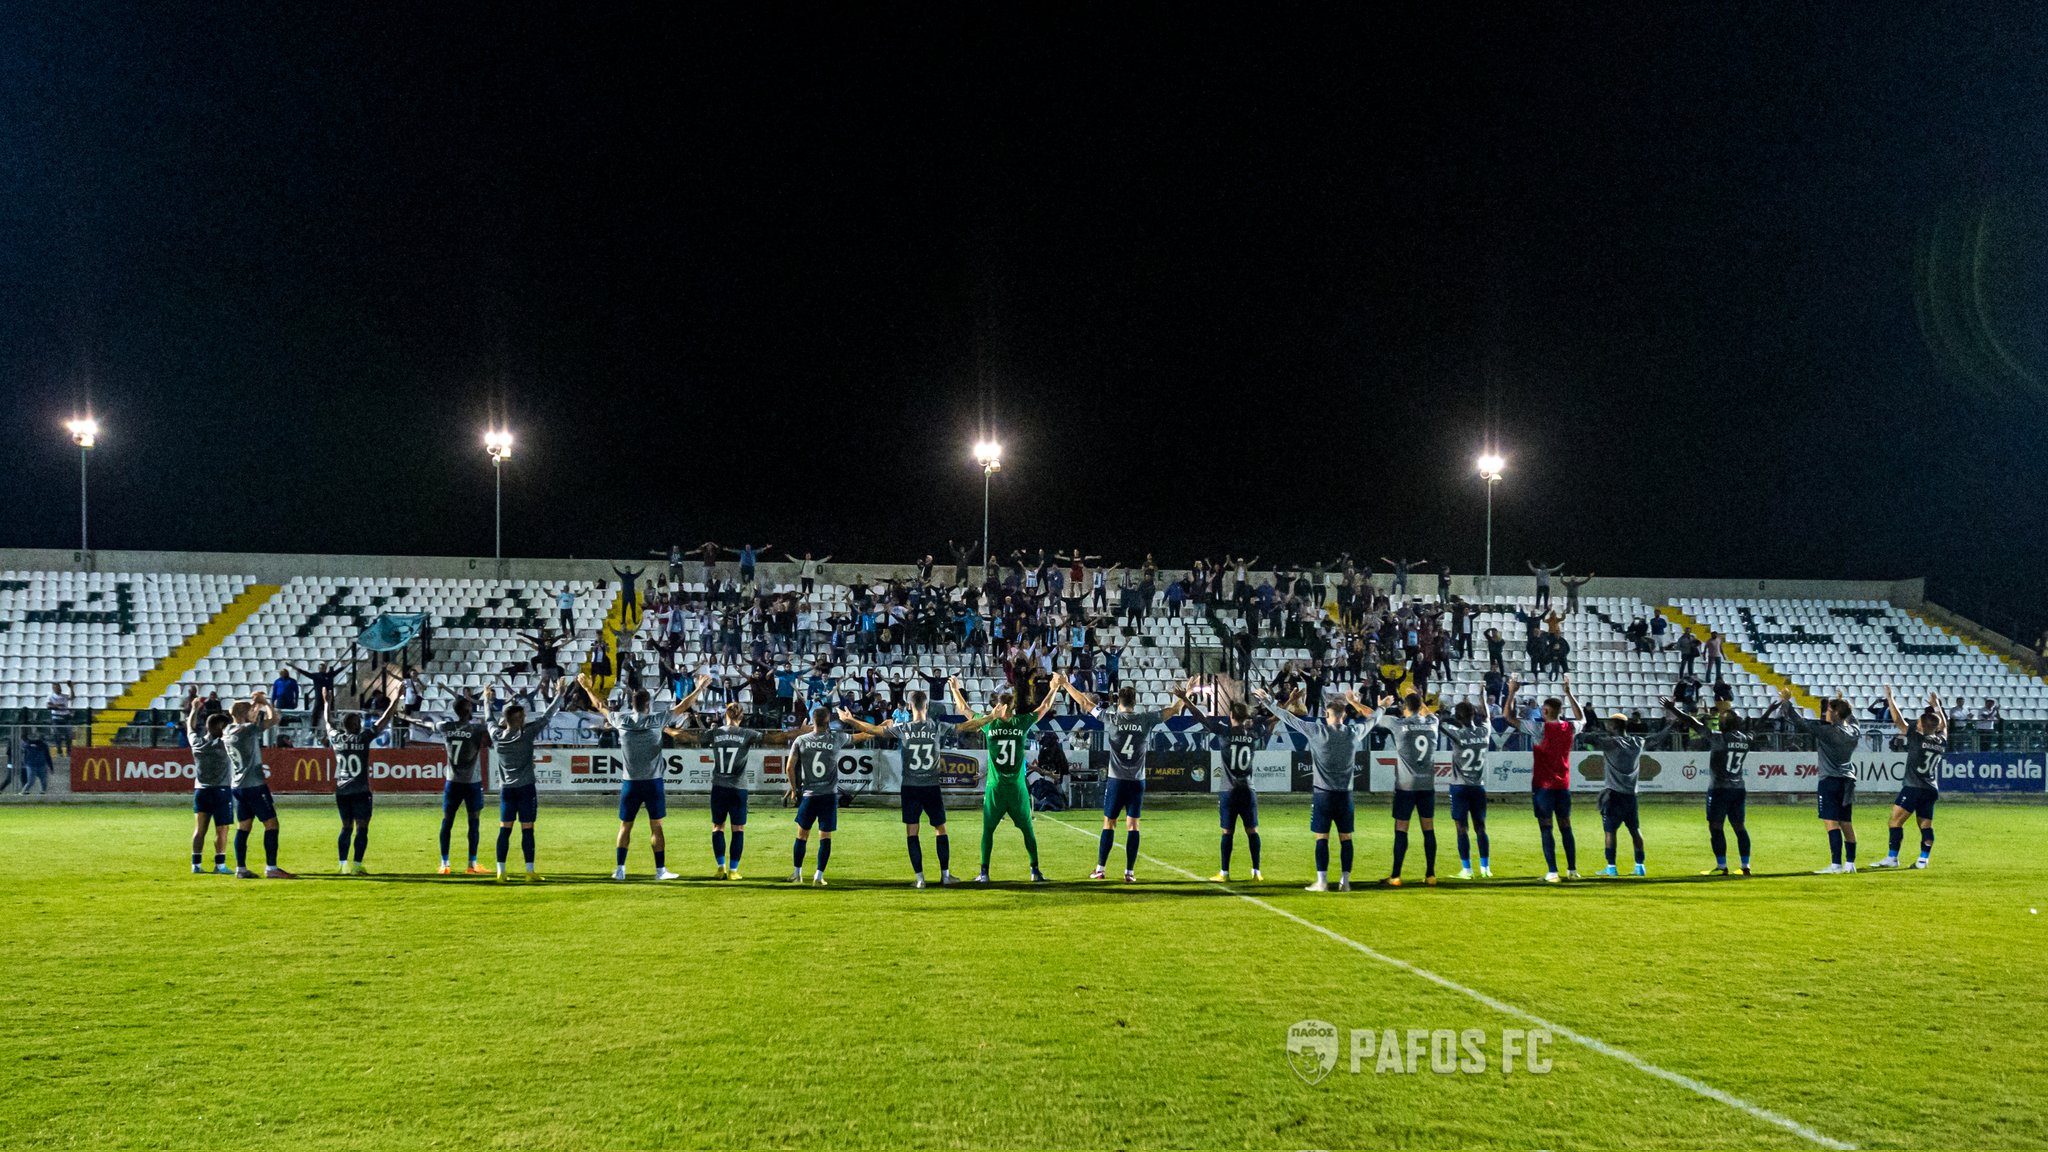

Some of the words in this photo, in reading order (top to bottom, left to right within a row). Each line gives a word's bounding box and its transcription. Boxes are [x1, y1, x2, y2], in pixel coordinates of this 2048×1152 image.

[469, 559, 476, 570] C
[447, 731, 472, 739] EMEDO
[988, 729, 1023, 737] ANTOSCH
[1118, 724, 1143, 732] KVIDA
[1120, 734, 1135, 760] 4
[1231, 736, 1252, 744] JAIRO
[1414, 735, 1429, 761] 9
[451, 740, 463, 766] 7
[718, 747, 739, 774] 17
[811, 751, 826, 778] 6
[908, 743, 935, 771] 33
[996, 740, 1016, 766] 31
[1230, 744, 1252, 771] 10
[1461, 748, 1486, 772] 25
[1726, 751, 1745, 774] 13
[1154, 768, 1186, 776] MARKET
[1757, 764, 1788, 779] SYM
[1941, 759, 1975, 779] bet
[1979, 764, 2002, 779] on
[2006, 759, 2042, 779] alfa
